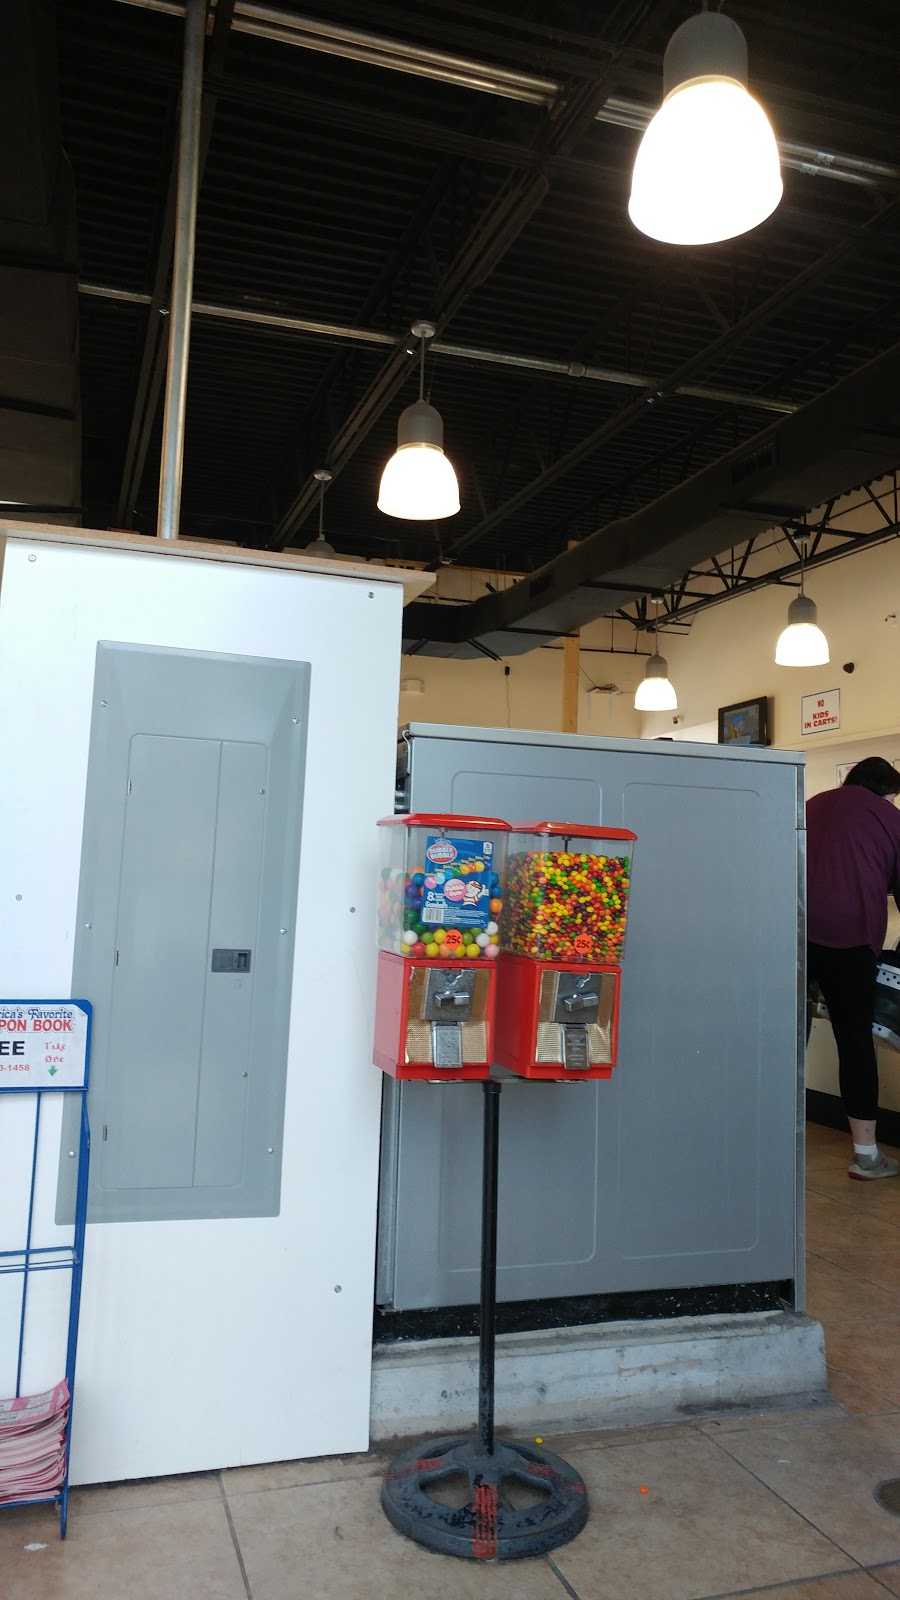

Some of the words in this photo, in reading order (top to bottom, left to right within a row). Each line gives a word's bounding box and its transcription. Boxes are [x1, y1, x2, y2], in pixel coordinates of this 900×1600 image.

[817, 699, 824, 708] NO
[812, 711, 829, 719] KIDS
[813, 716, 837, 727] CARTS!
[28, 1008, 73, 1020] Favorite
[0, 1019, 26, 1031] PON
[33, 1019, 72, 1031] BOOK
[0, 1041, 25, 1055] EE
